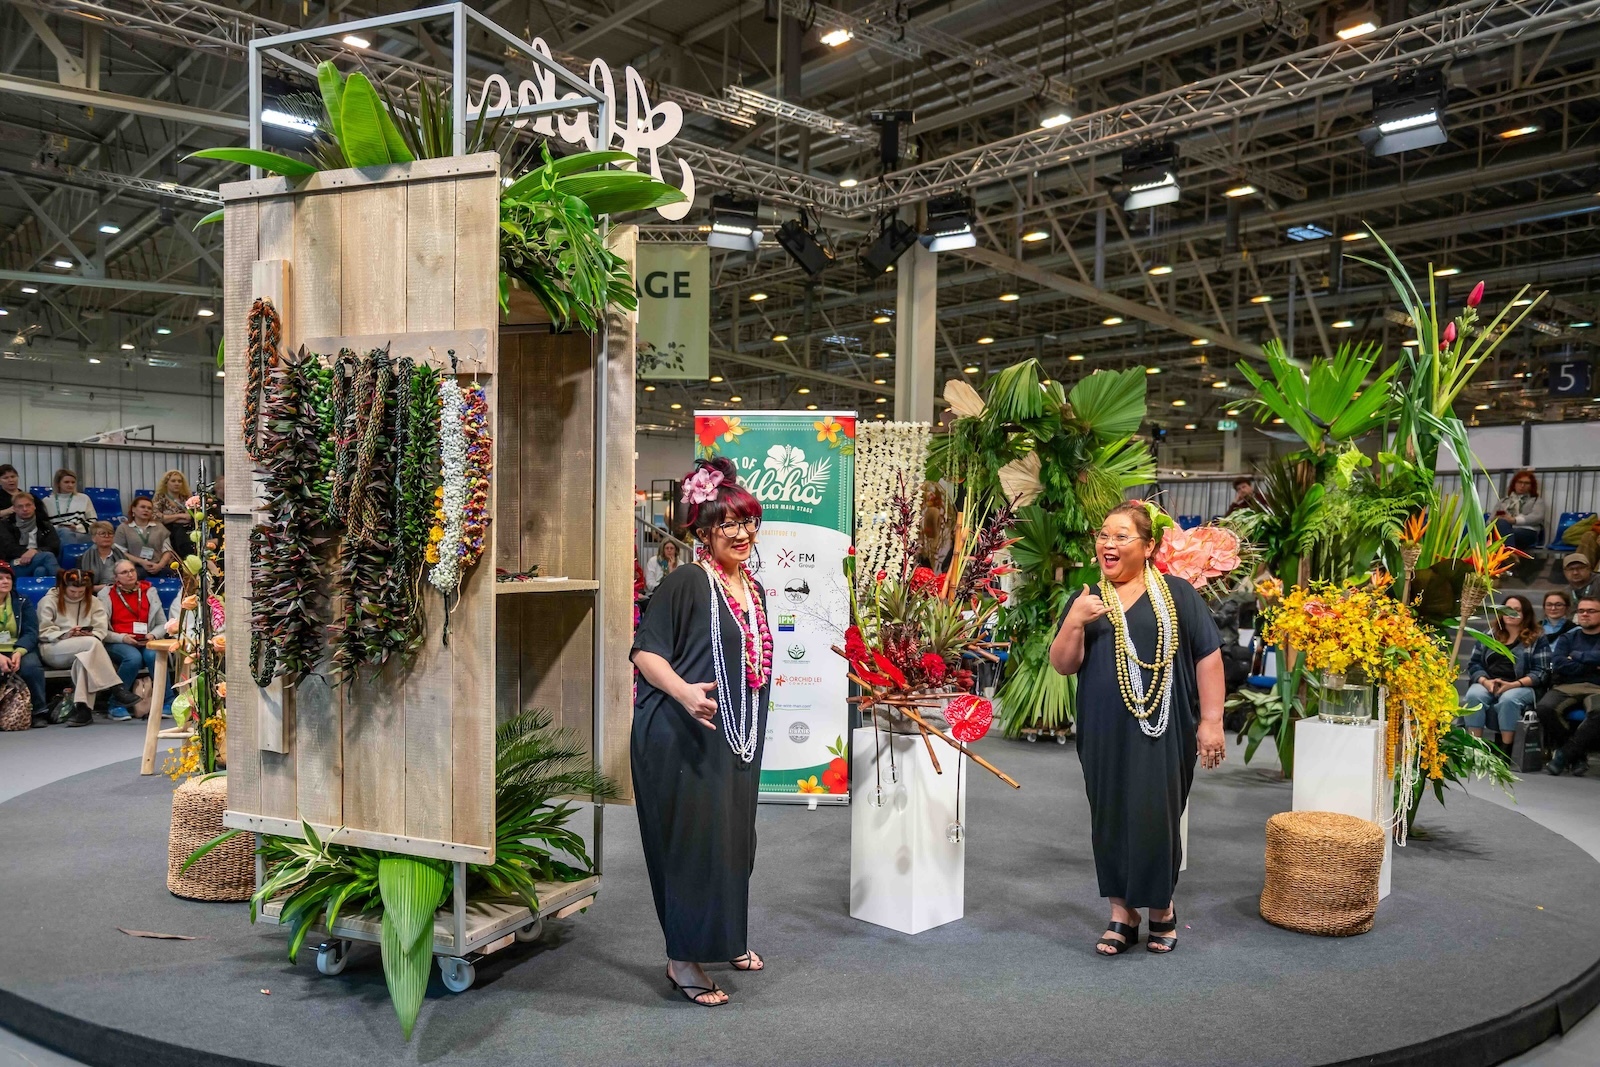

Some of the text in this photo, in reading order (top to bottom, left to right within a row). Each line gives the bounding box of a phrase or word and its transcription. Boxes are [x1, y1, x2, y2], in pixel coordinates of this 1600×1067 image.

[636, 271, 691, 298] GE
[1557, 364, 1575, 391] 5
[741, 456, 757, 470] OF
[736, 467, 822, 505] Aloha
[796, 505, 813, 514] STAGE
[798, 553, 815, 563] FM
